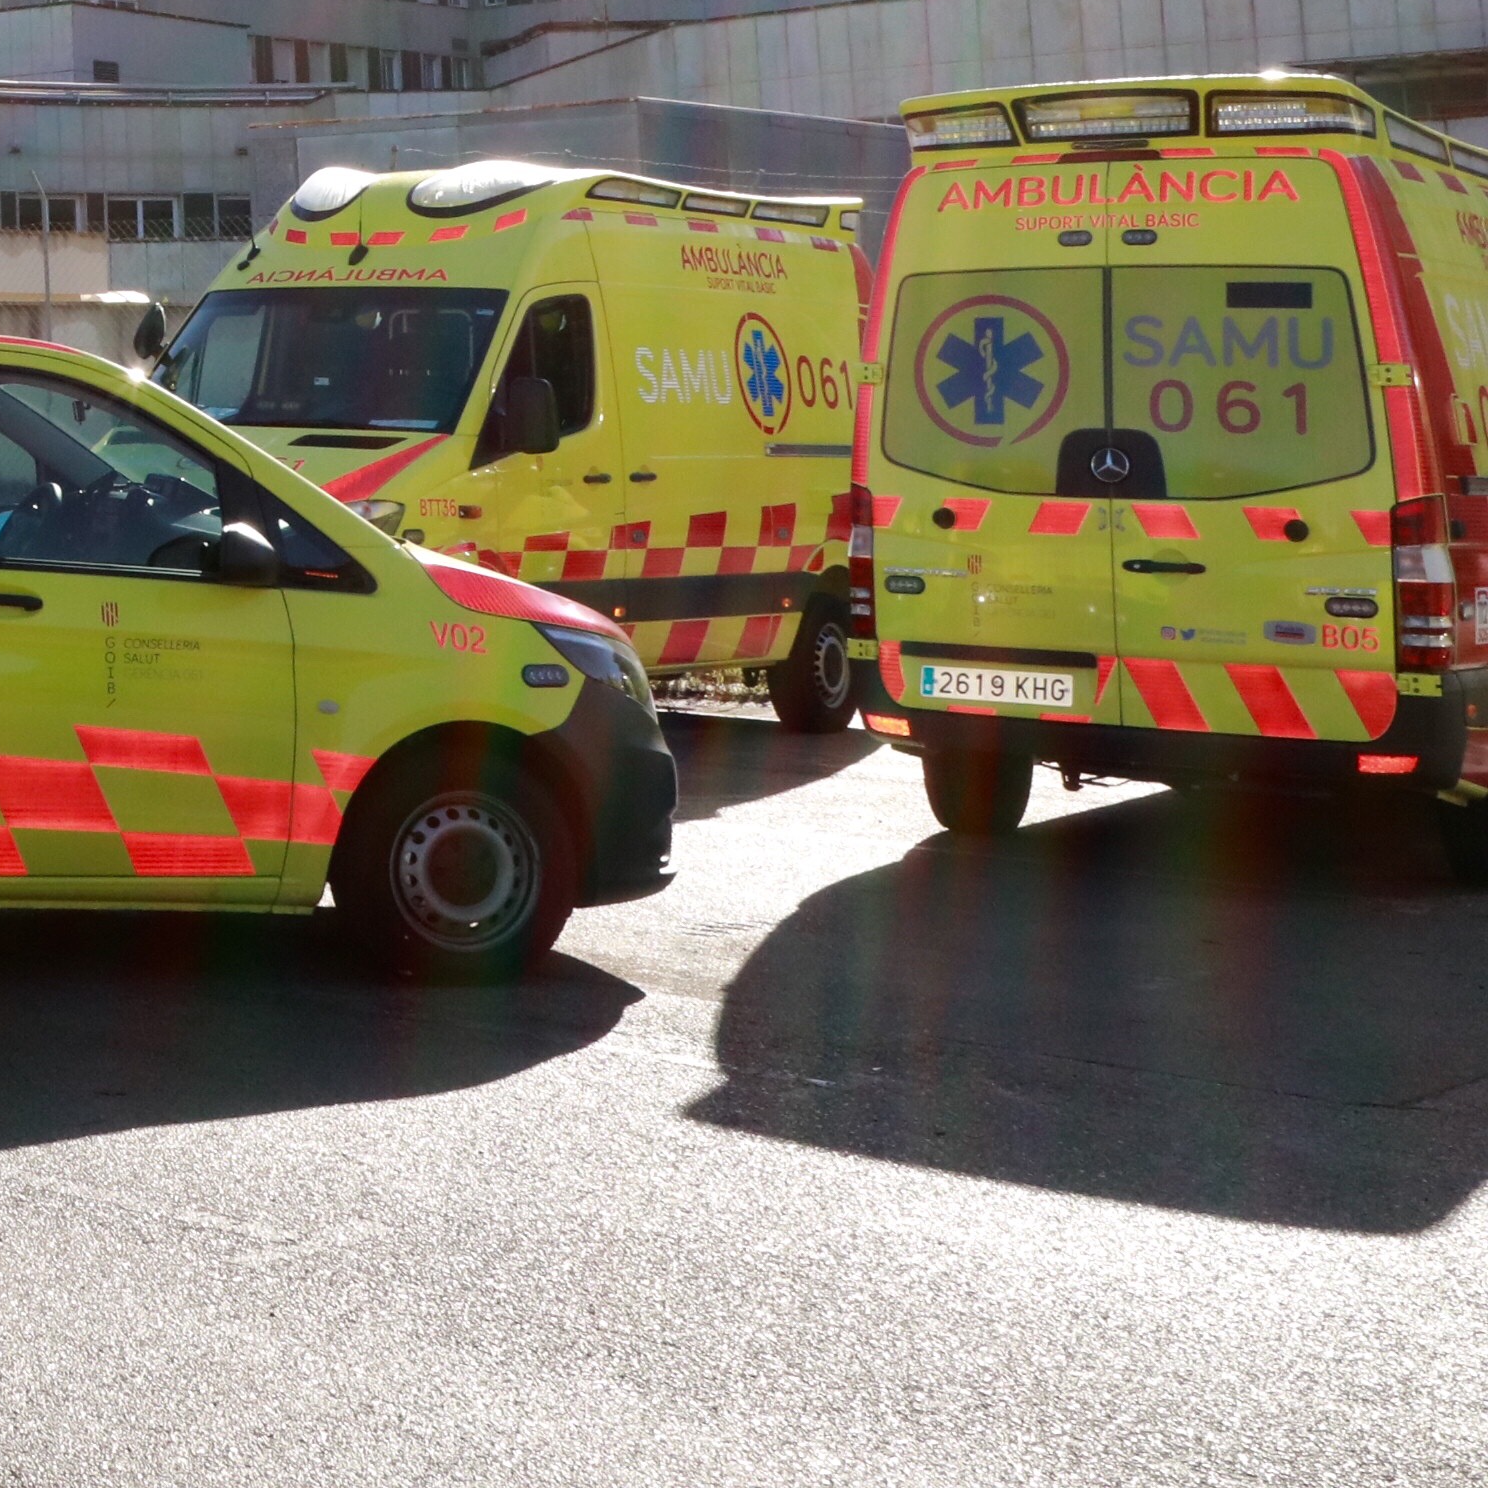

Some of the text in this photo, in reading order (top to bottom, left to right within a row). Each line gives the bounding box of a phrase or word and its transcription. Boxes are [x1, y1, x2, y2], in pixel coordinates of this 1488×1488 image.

[937, 163, 1300, 212] AMBULÀNCIA
[1015, 215, 1084, 231] SUPORT
[1090, 214, 1140, 229] VITAL
[681, 243, 788, 280] AMBULÀNCIA
[1123, 315, 1334, 369] SAMU
[635, 347, 853, 410] SAMU 061
[1149, 379, 1307, 435] 061
[419, 499, 457, 517] BTT36
[123, 638, 201, 651] CONSELLERIA
[429, 621, 487, 654] V02
[1322, 624, 1380, 652] B05
[123, 653, 160, 664] SALUT
[939, 672, 1066, 701] 2619 KHG
